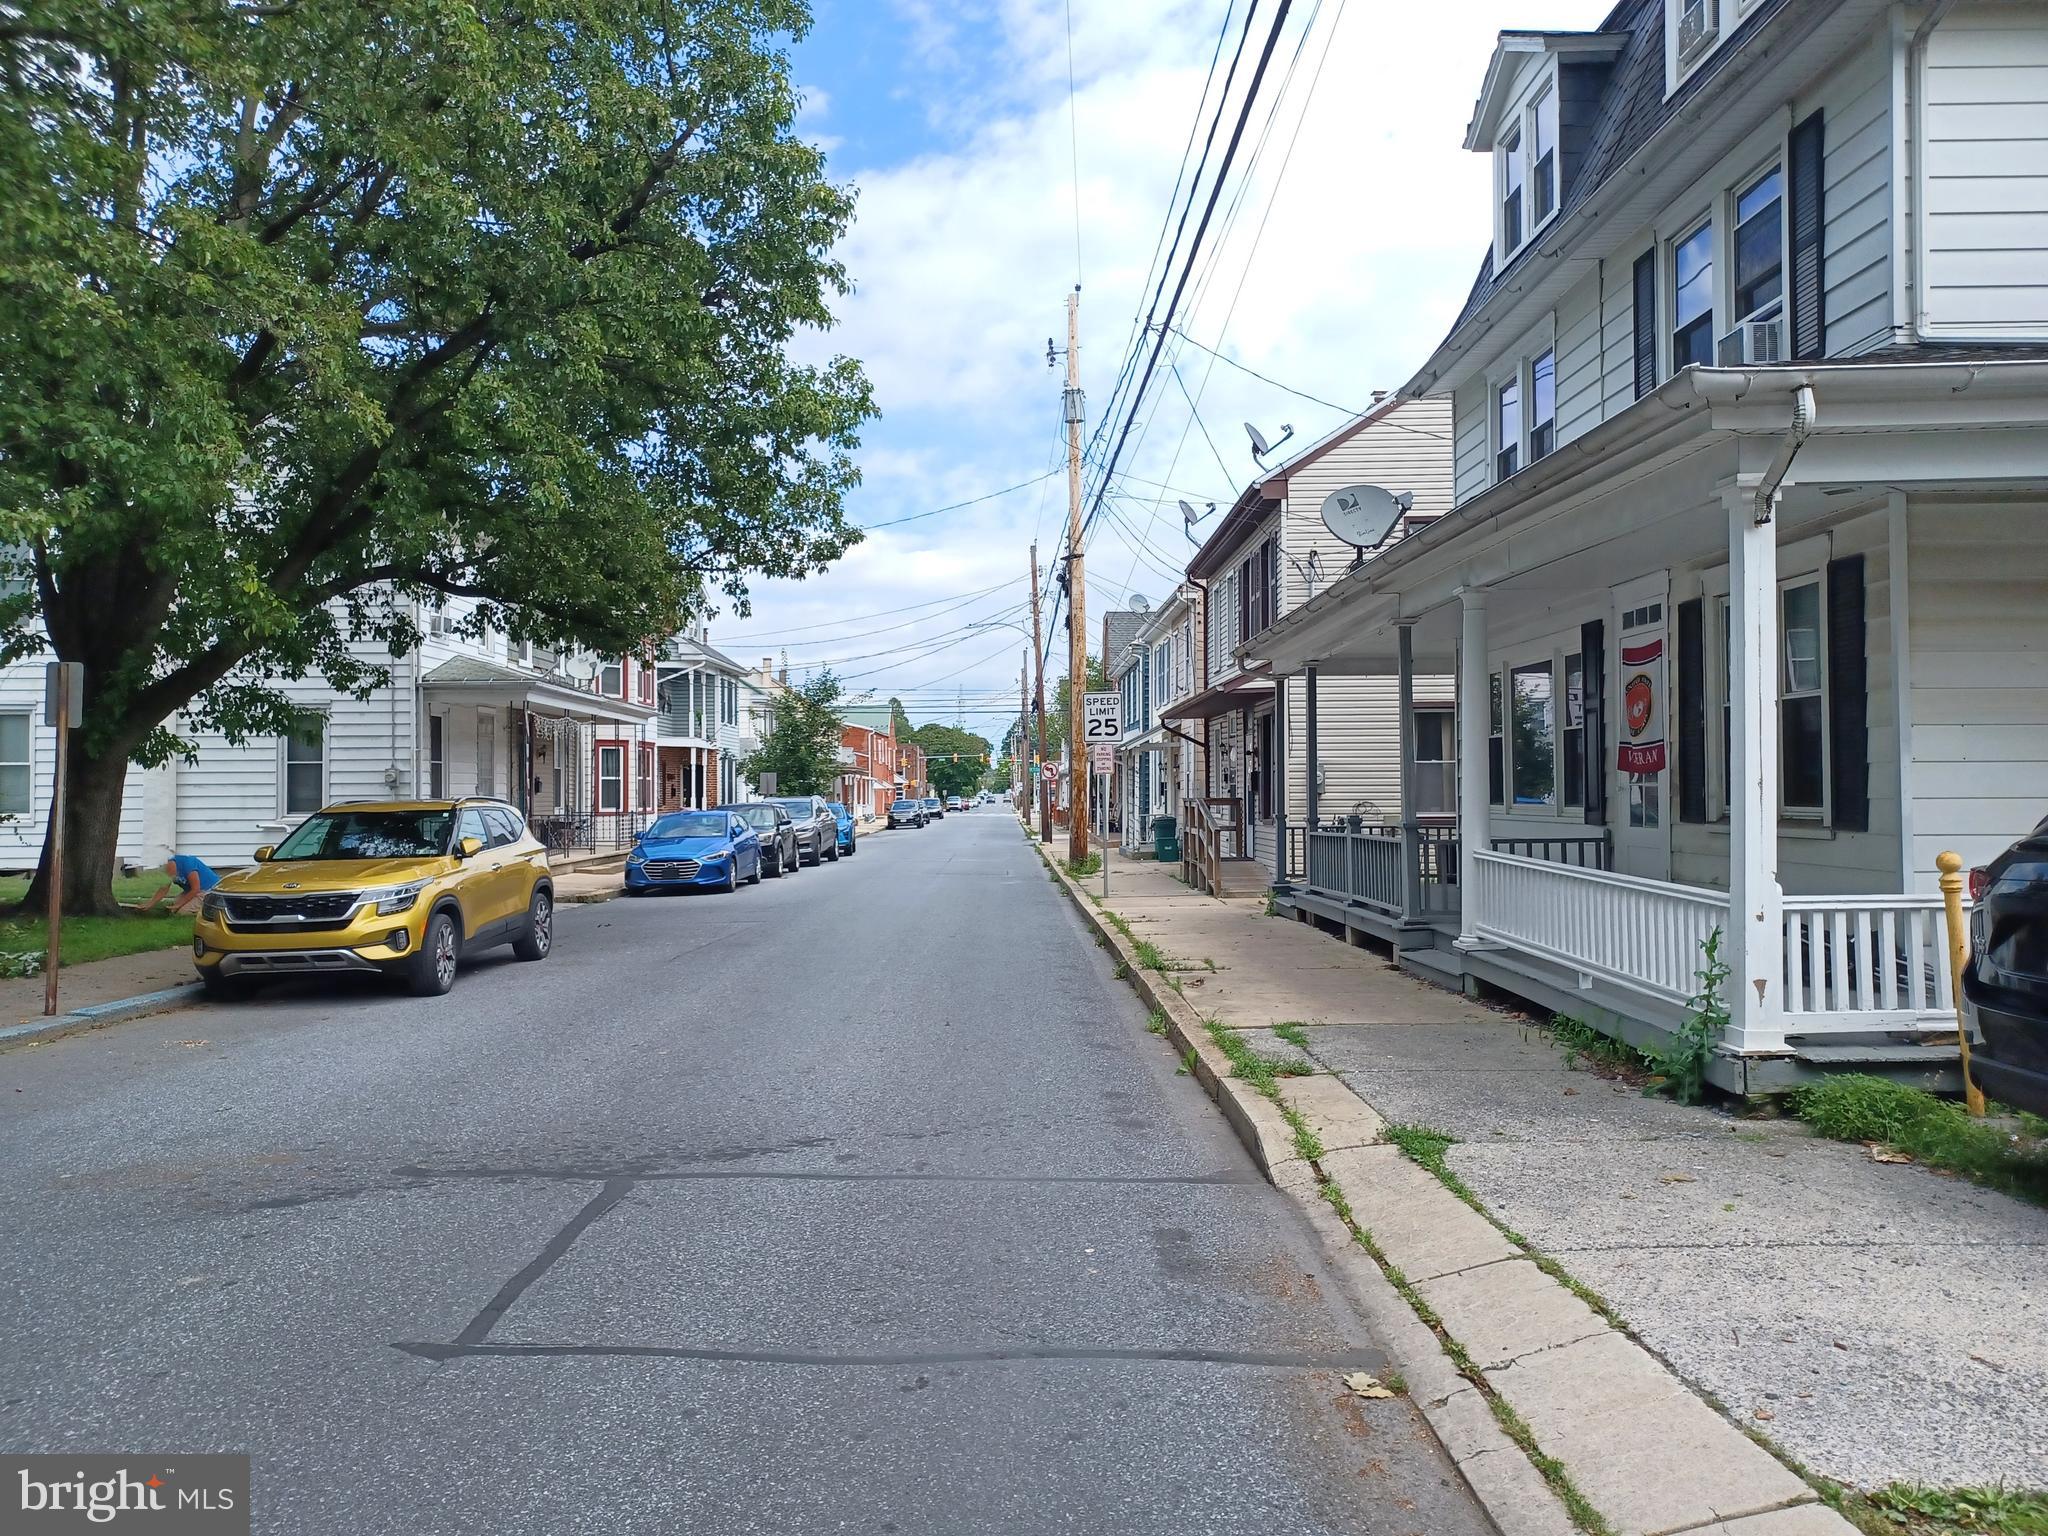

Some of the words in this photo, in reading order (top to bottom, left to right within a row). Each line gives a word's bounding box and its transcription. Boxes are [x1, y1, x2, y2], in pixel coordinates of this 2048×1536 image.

[1086, 697, 1119, 706] SPEED
[1090, 707, 1116, 716] LIMIT
[1088, 718, 1118, 737] 25
